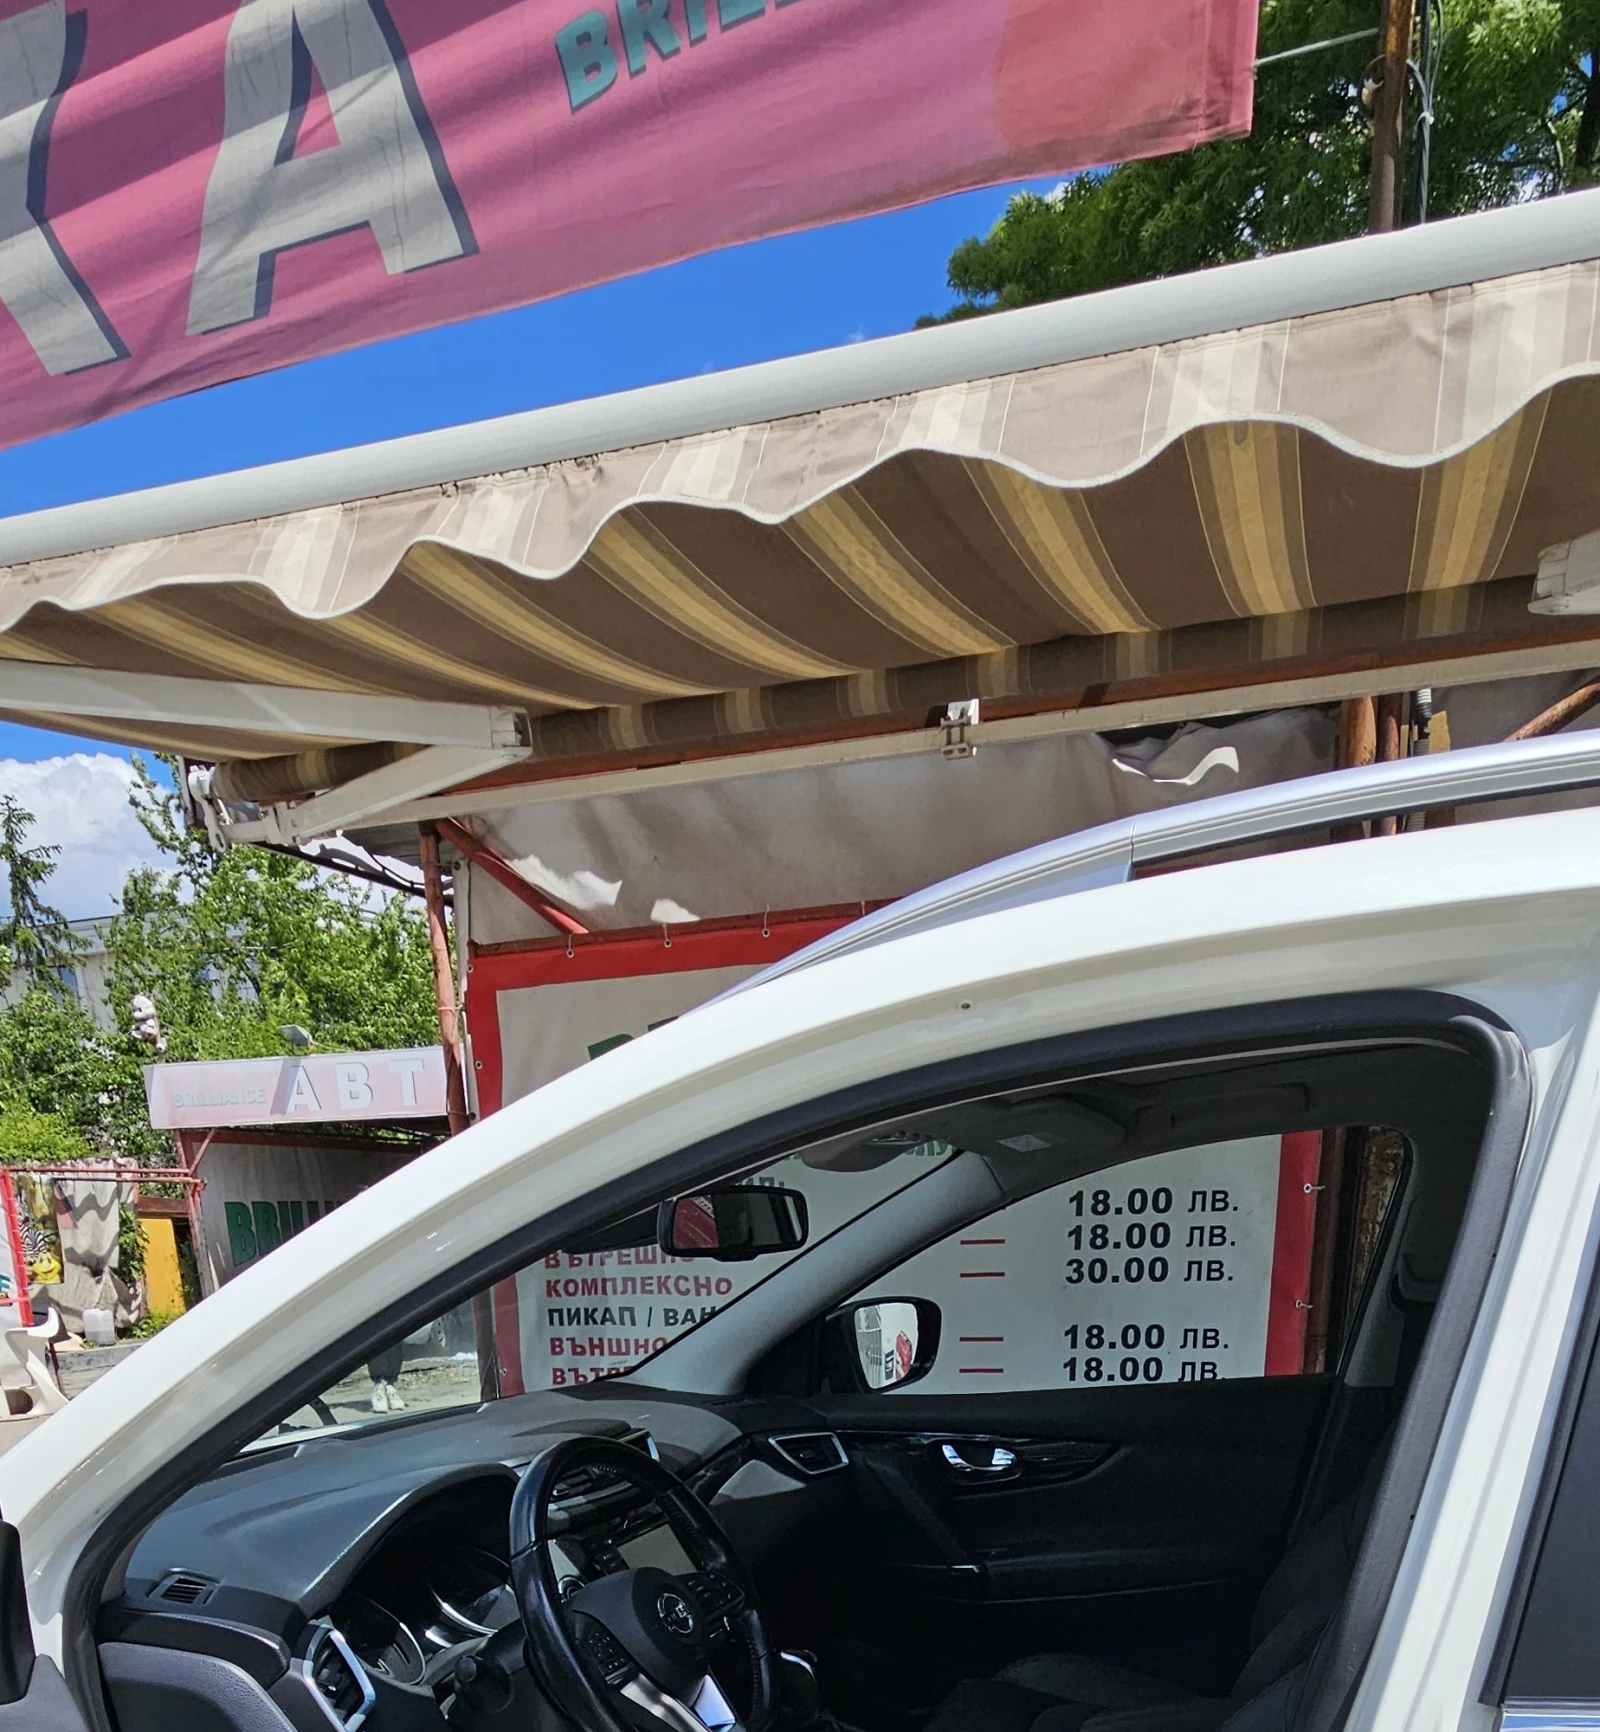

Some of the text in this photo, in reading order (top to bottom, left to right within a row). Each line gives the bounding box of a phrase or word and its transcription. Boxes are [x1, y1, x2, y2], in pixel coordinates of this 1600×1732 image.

[555, 0, 806, 114] BRI
[173, 1088, 267, 1108] BRILLIANCE
[1069, 1187, 1173, 1217] 18.00
[1067, 1222, 1171, 1251] 18.00
[544, 1246, 695, 1269] ВЪТРЕШН
[1065, 1256, 1169, 1284] 30.00
[545, 1275, 733, 1298] КОМПЛЕКСНО
[548, 1306, 637, 1327] ПИКАП
[663, 1306, 717, 1327] ВАН
[550, 1337, 668, 1357] ВЪНШНО
[1064, 1324, 1165, 1350] 18.00
[552, 1365, 634, 1386] ВЪТ
[1063, 1357, 1163, 1382] 18.00
